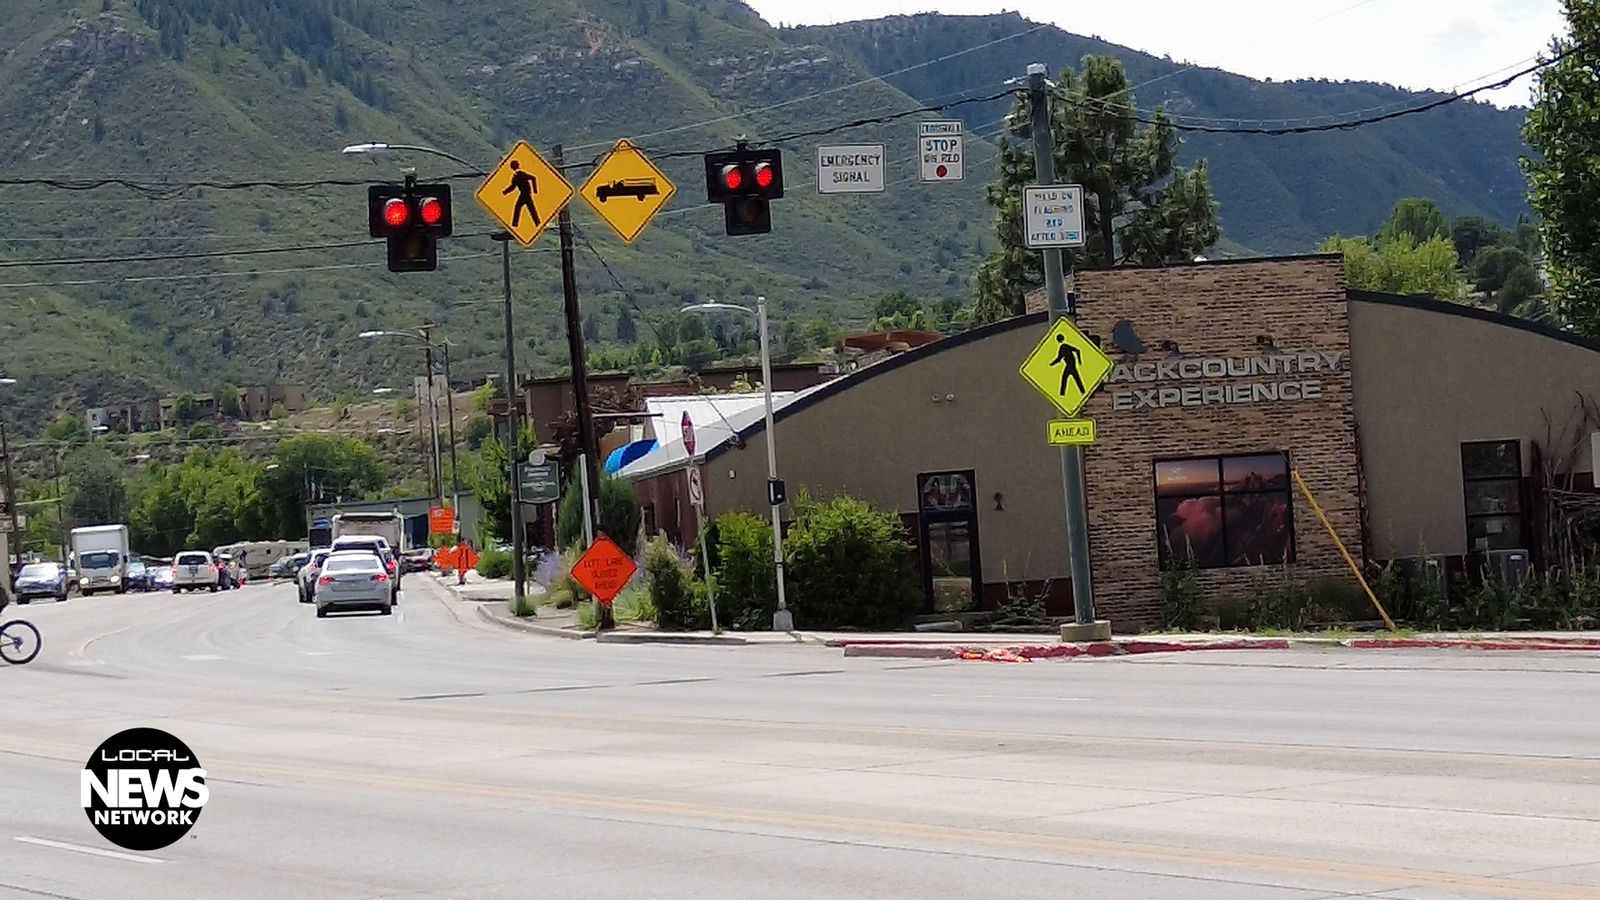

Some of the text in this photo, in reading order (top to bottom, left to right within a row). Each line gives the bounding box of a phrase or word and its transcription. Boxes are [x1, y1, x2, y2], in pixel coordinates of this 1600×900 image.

[926, 140, 957, 152] STOP
[821, 155, 881, 168] EMERGENCY
[942, 153, 961, 163] RED
[833, 171, 870, 184] SIGNAL
[1105, 352, 1341, 382] ACKCOUNTRY
[1112, 381, 1323, 410] EXPERIENCE
[1054, 427, 1090, 437] AHEAD
